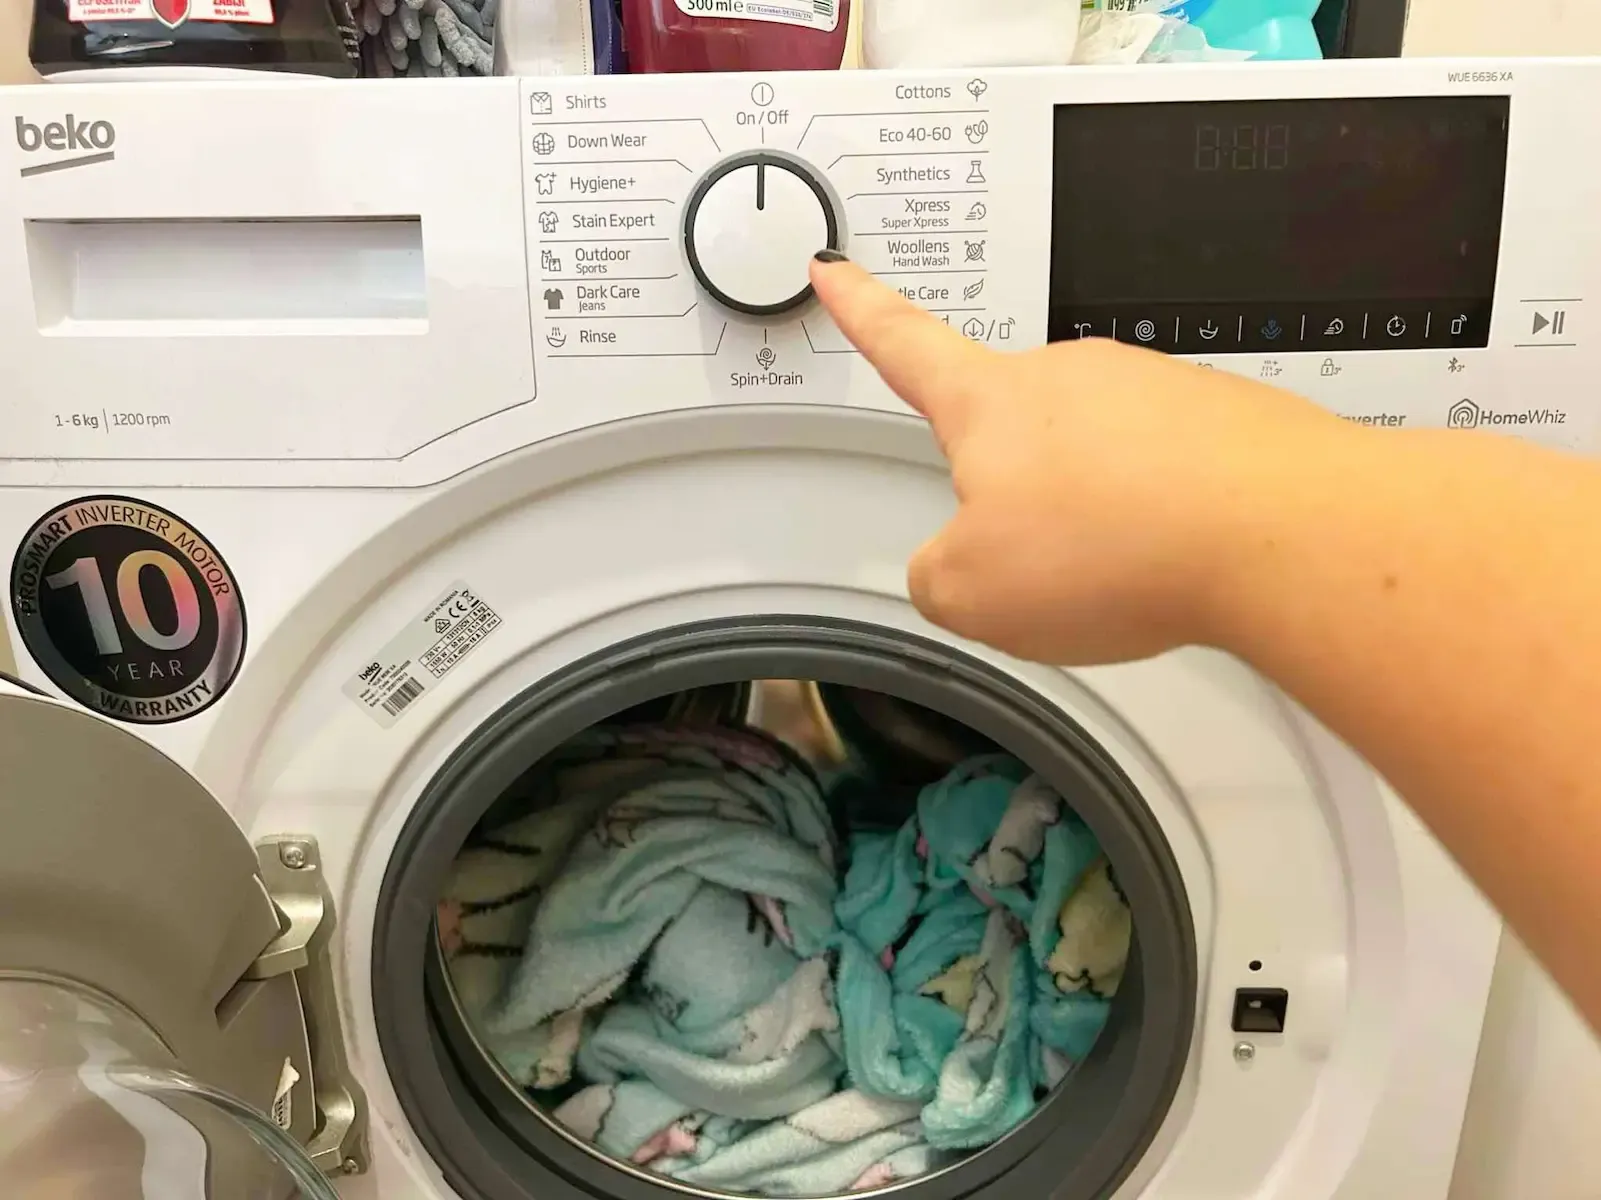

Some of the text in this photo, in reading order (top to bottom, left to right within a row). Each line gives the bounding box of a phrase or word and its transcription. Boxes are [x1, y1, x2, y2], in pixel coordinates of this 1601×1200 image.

[1447, 71, 1514, 82] WUE 6636 XA
[895, 85, 951, 99] Cottons
[565, 95, 607, 109] Shirts
[736, 111, 756, 125] On
[767, 110, 790, 124] Off
[15, 114, 116, 151] beko
[879, 127, 952, 142] Eco 40-60
[567, 134, 647, 149] Down Wear
[876, 166, 951, 185] Synthetics
[570, 176, 637, 193] Hygiene+
[904, 198, 951, 214] Xpress
[572, 212, 656, 231] Stain Expert
[881, 216, 950, 229] Super Xpress
[575, 247, 631, 261] Outdoor
[887, 239, 950, 254] Woollens
[892, 255, 950, 267] Hand Wash
[575, 263, 608, 275] Sports
[576, 284, 641, 299] Dark Care
[918, 286, 949, 300] Care
[578, 301, 606, 313] Jeans
[579, 329, 617, 343] Rinse
[730, 371, 803, 388] Spin+Drain
[83, 414, 99, 429] kg
[112, 413, 145, 426] 1200
[146, 415, 171, 428] rpm
[1336, 413, 1407, 427] verter
[1480, 409, 1567, 425] HomeWhiz
[20, 505, 230, 615] PROSMART INVERTER MOTOR
[46, 549, 201, 655] 10
[107, 659, 185, 681] YEAR
[358, 662, 380, 680] beko
[99, 679, 214, 717] WARRANTY
